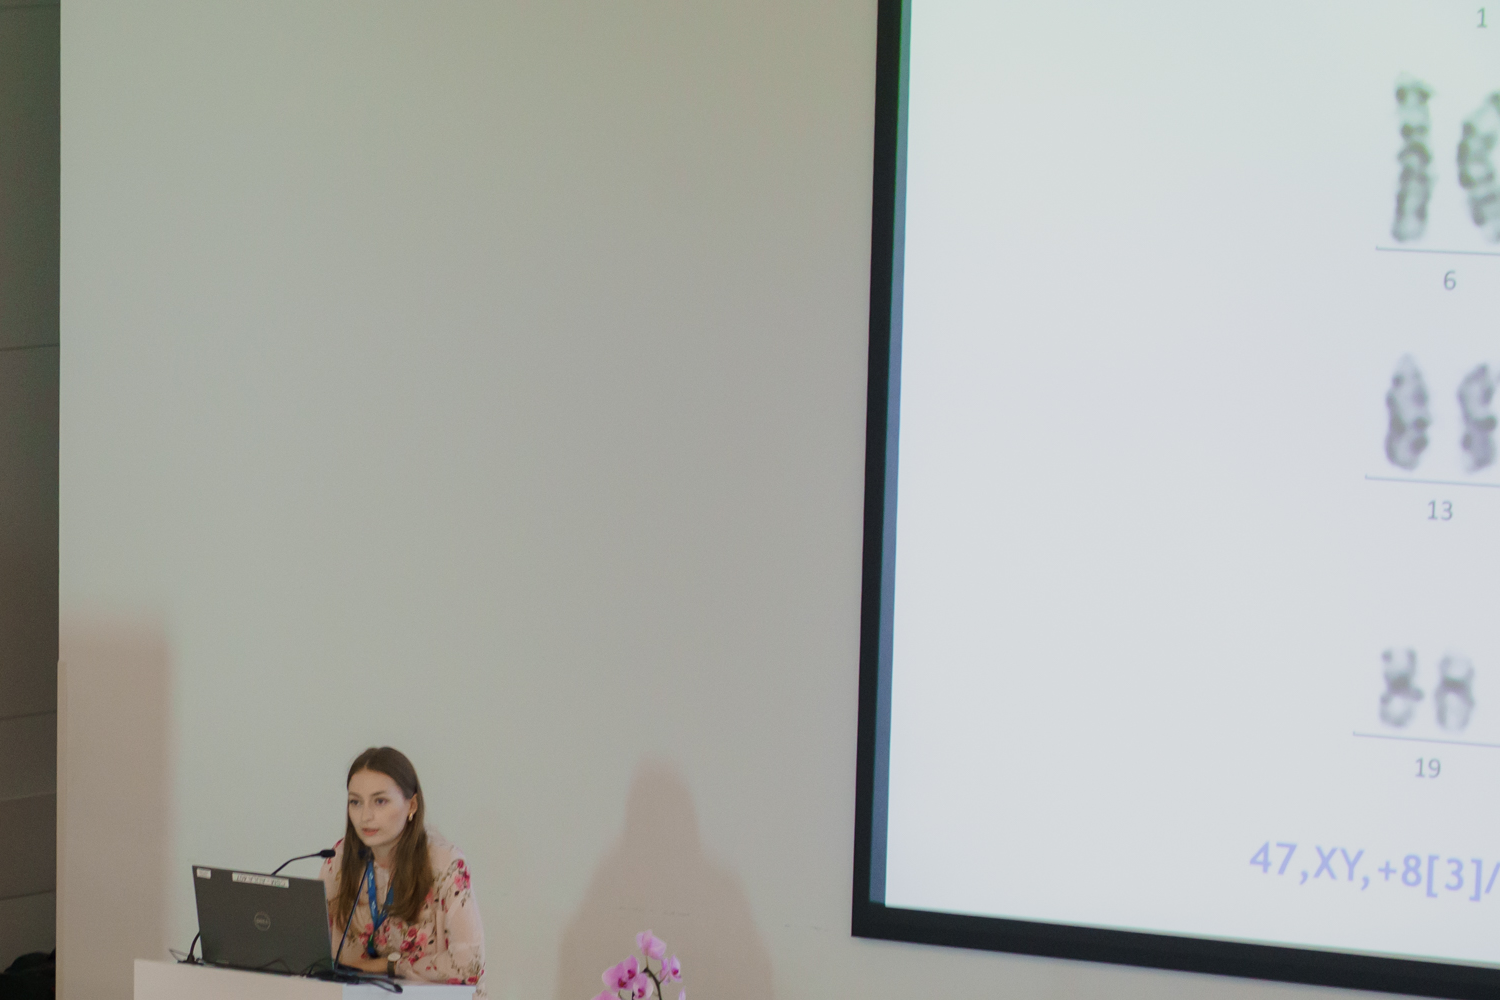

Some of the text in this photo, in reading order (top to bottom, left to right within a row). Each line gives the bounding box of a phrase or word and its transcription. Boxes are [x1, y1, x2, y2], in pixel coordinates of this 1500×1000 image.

[1476, 7, 1488, 29] 1
[1443, 269, 1456, 291] 6
[1427, 500, 1454, 521] 13
[1414, 757, 1441, 779] 19
